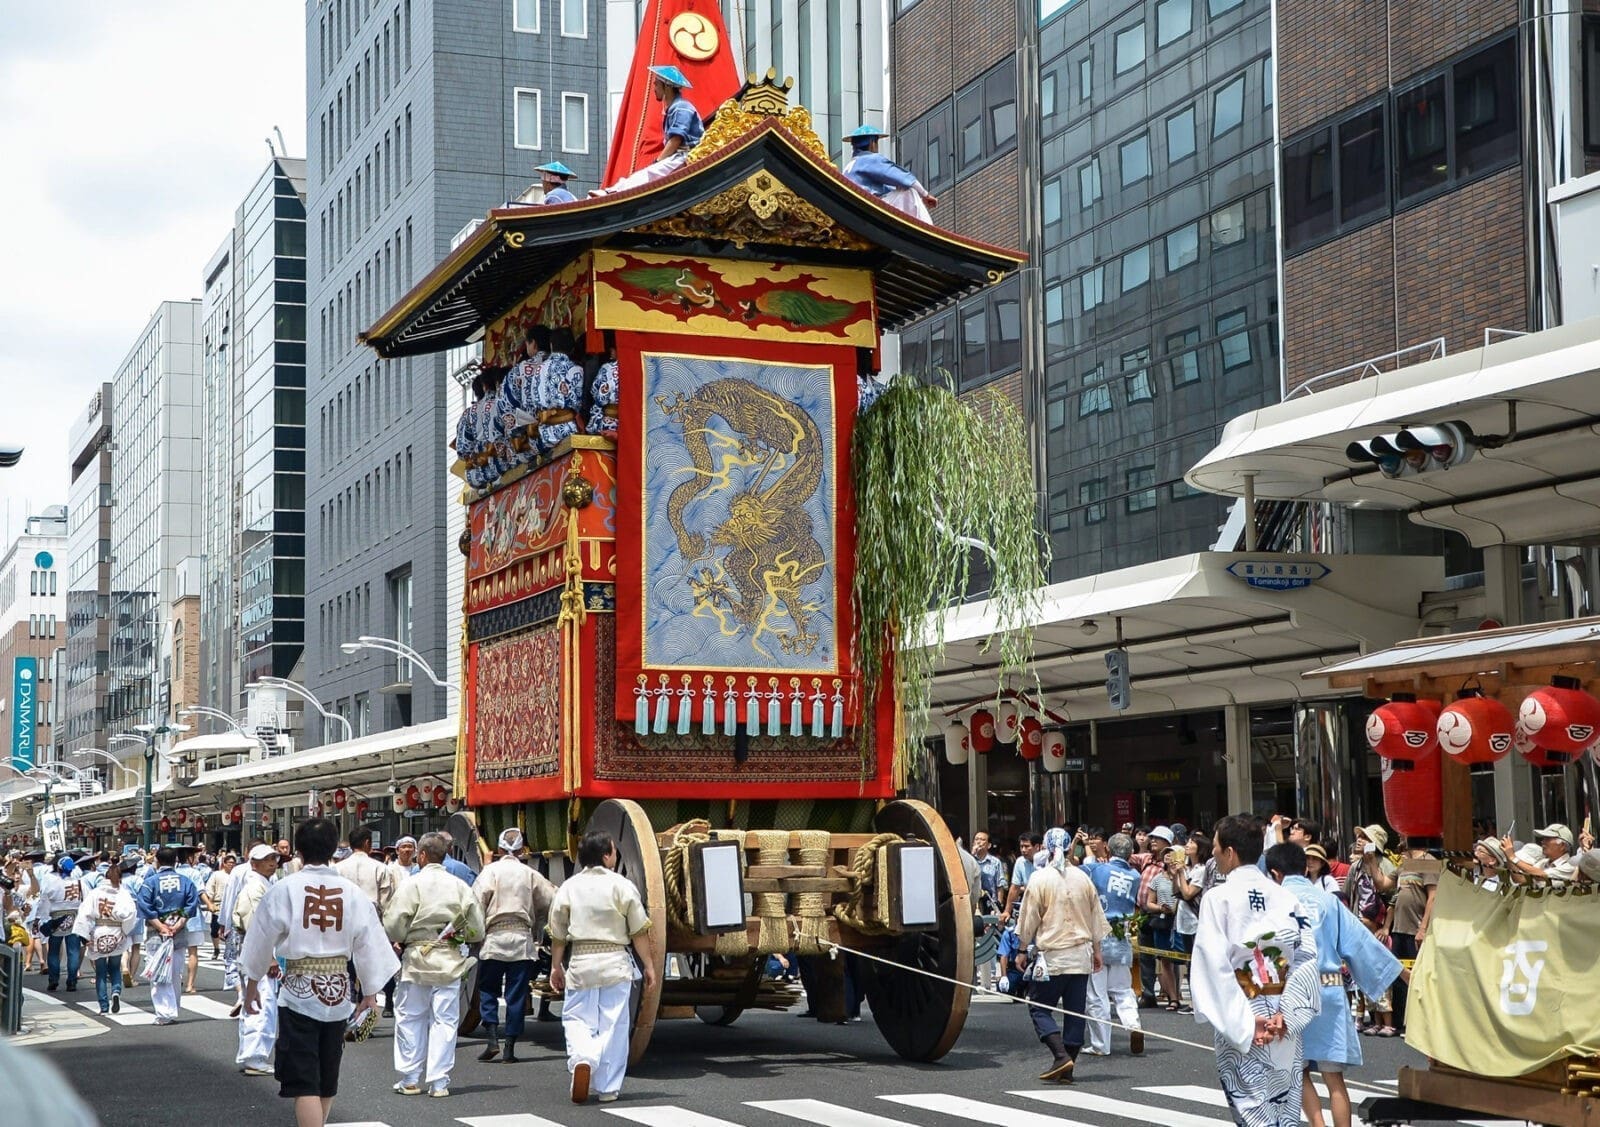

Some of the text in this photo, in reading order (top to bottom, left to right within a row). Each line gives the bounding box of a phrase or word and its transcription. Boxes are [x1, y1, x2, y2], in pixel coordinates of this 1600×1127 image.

[1245, 565, 1312, 575] 富小路通り
[18, 683, 31, 758] DAIMARU
[159, 875, 181, 893] 南
[1107, 870, 1135, 899] 南
[302, 884, 344, 933] 南
[1247, 888, 1266, 912] 南
